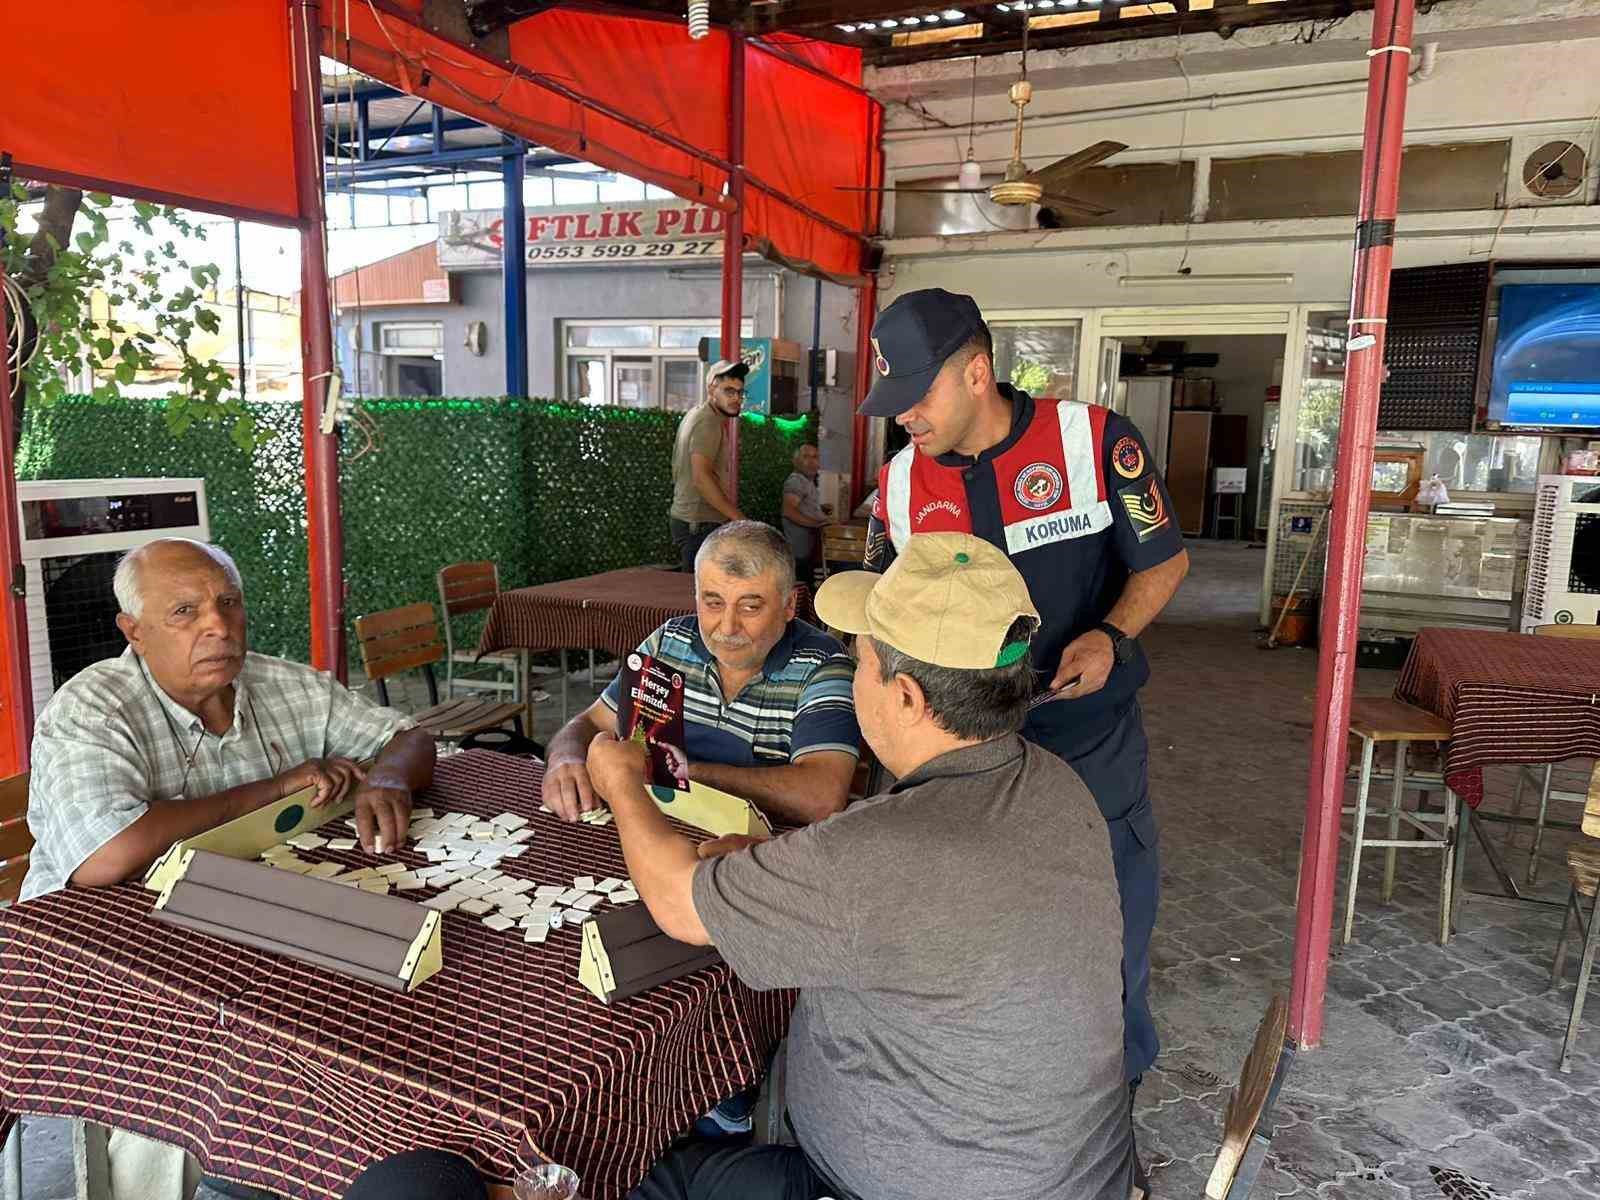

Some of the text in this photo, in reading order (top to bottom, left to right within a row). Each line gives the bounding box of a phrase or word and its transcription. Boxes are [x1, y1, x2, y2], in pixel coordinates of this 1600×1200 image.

[489, 202, 727, 246] ÇFTLİK PİD
[528, 242, 715, 259] 0553 599 29 27
[915, 500, 961, 524] JANDARMA
[1025, 513, 1092, 543] KORUMA
[641, 675, 669, 698] Herşey
